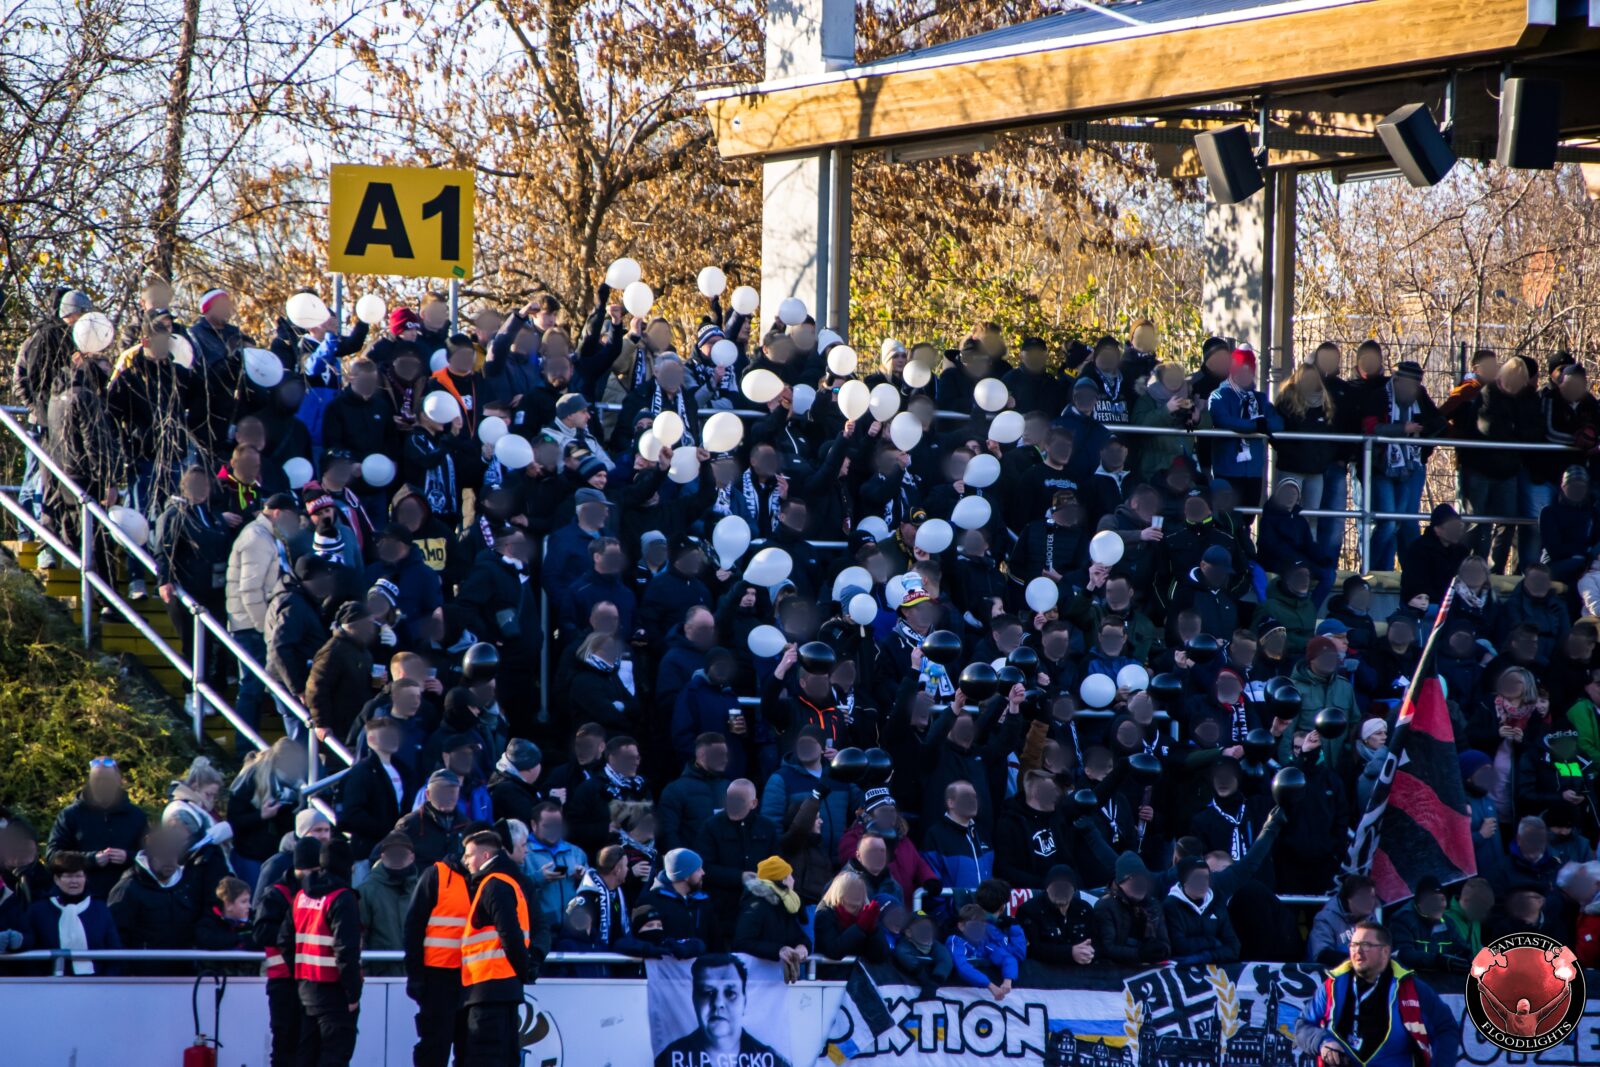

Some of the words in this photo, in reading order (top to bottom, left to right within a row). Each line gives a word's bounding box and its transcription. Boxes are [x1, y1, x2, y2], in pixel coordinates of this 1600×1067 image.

[343, 181, 461, 262] A1
[1547, 729, 1579, 740] adida
[846, 996, 1049, 1058] KTION
[716, 1051, 774, 1067] GECKO
